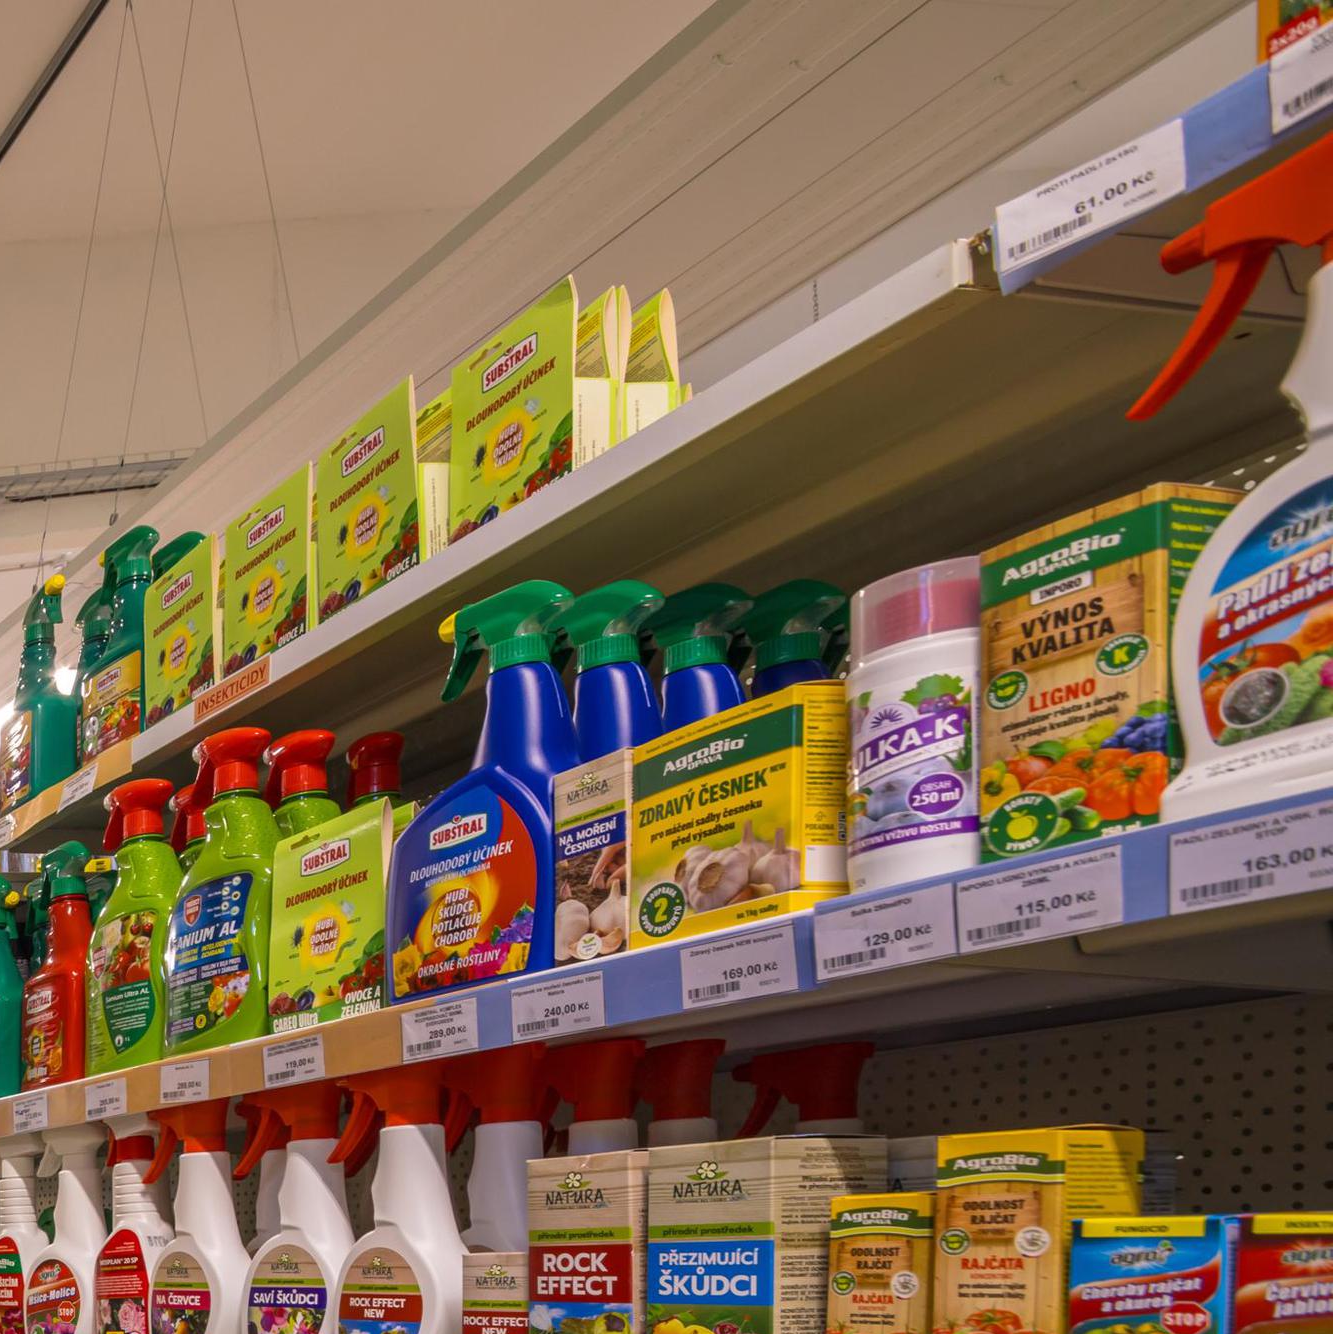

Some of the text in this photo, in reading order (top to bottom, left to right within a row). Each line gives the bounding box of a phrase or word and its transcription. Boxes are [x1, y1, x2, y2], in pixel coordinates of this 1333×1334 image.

[484, 339, 535, 389] SUBSTRAL
[465, 357, 557, 433] DLOUHODOBÝ ÚČINEK
[343, 432, 384, 473] SUBSTRAL
[1002, 532, 1122, 586] AgroBio
[1039, 577, 1082, 601] INPORO
[1217, 562, 1293, 620] Padlí
[1020, 596, 1105, 640] VÝNOS
[1011, 616, 1115, 666] KVALITA
[196, 663, 268, 716] INSEKTICIDY
[1028, 678, 1096, 713] LIGNO
[638, 761, 788, 828] ZDRAVÝ ČESNEK NEW
[911, 785, 962, 806] 250 ml
[920, 781, 952, 794] OBSAH
[430, 813, 487, 848] SUBSTRAL
[558, 817, 618, 848] NA MOŘENÍ
[649, 799, 763, 846] pro máčení sadby česneku
[563, 831, 612, 857] ČESNEKU
[409, 838, 513, 883] DLOUHODOBÝ ÚČINEK
[1242, 846, 1317, 874] 163,00
[438, 898, 475, 920] ŠKŮDCE
[444, 888, 471, 905] HUBÍ
[1015, 889, 1096, 917] 115,00 Kč
[431, 911, 483, 937] POTLAČUJE
[863, 922, 933, 948] 129,00 Kč
[434, 926, 480, 950] CHOROBY
[417, 948, 501, 981] OKRASNÉ ROSTLINY
[963, 1198, 1025, 1212] ODOLNOST
[542, 1251, 608, 1273] ROCK
[658, 1249, 759, 1267] PŘEZIMUJÍCÍ
[961, 1254, 1024, 1272] RAJČATA
[536, 1275, 619, 1296] EFFECT
[658, 1266, 759, 1297] ŠKŮDCI
[1081, 1285, 1145, 1302] Choroby
[253, 1287, 319, 1306] SAVÍ ŠKŮDCI
[349, 1297, 406, 1311] ROCK EFFECT
[1164, 1312, 1207, 1329] STOP
